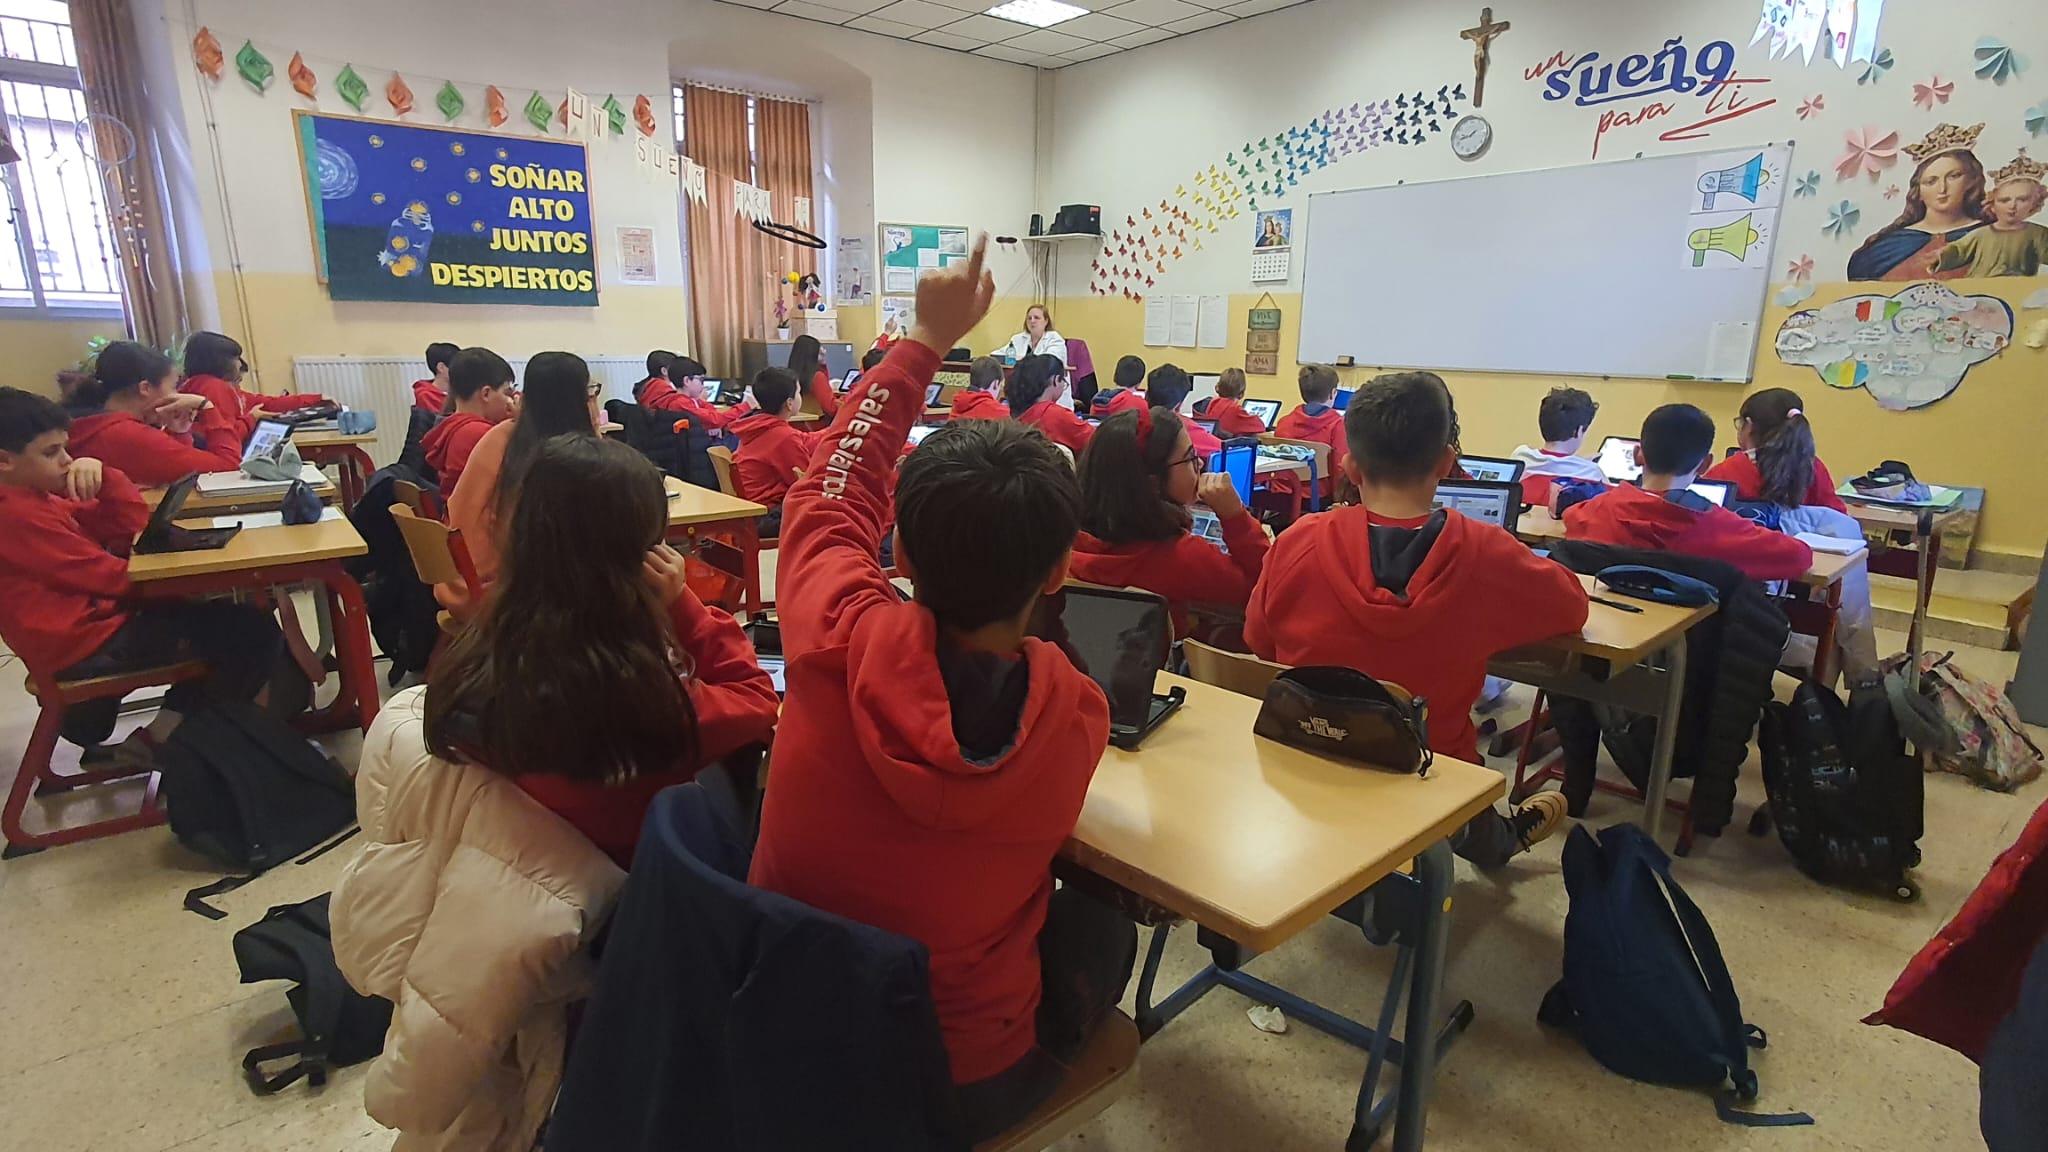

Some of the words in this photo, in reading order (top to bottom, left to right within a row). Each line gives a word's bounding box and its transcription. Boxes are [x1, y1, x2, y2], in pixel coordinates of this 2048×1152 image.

[1524, 50, 1575, 81] un
[1592, 101, 1676, 160] para
[489, 163, 585, 193] SOÑAR
[509, 196, 575, 222] ALTO
[490, 227, 588, 254] JUNTOS
[430, 262, 593, 292] DESPIERTOS
